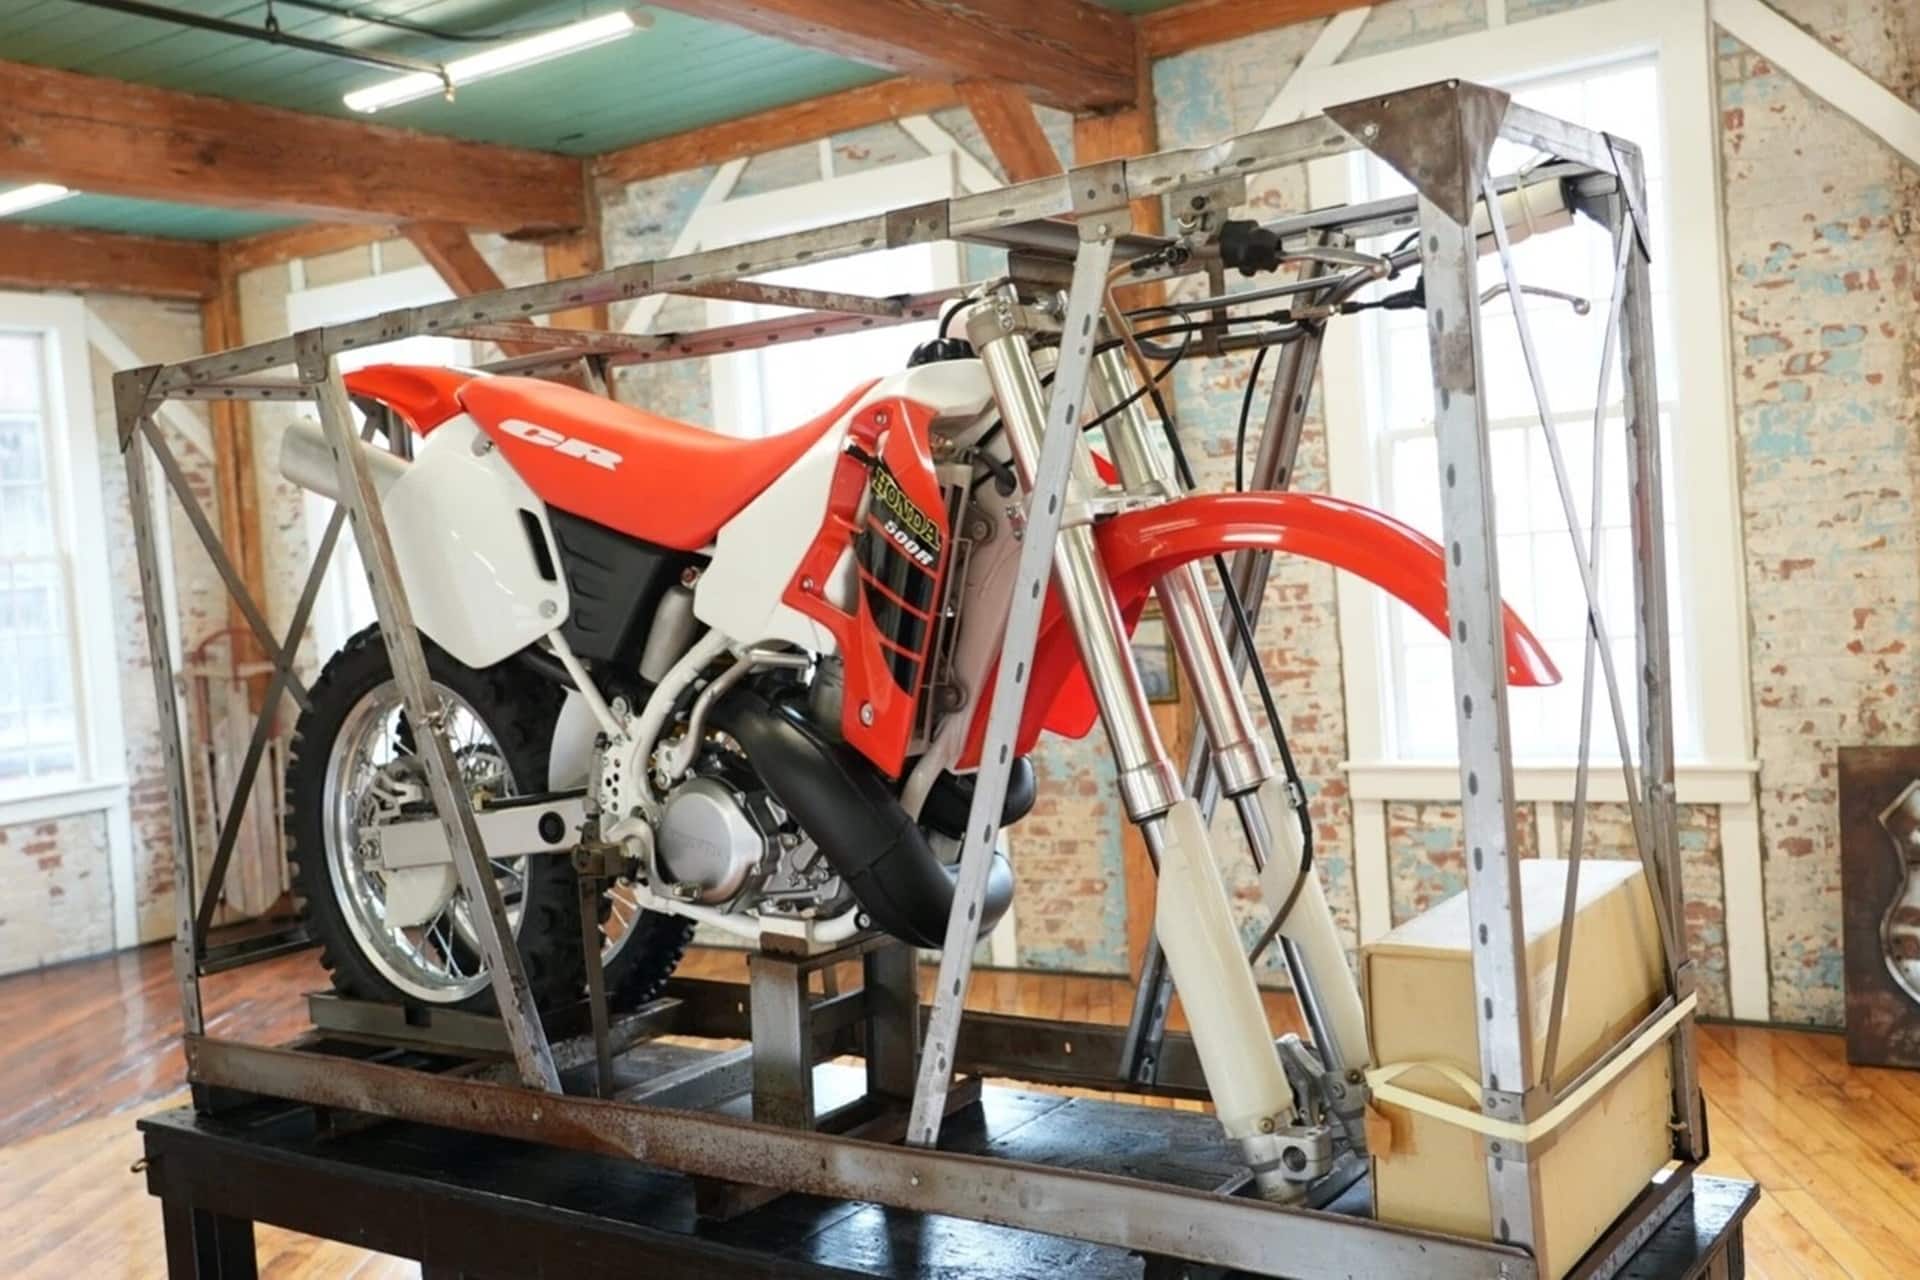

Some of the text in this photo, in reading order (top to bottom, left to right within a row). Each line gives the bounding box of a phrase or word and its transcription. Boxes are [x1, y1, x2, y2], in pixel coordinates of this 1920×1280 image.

[498, 418, 623, 471] CR
[872, 467, 941, 551] HONDA
[884, 519, 934, 565] 500R
